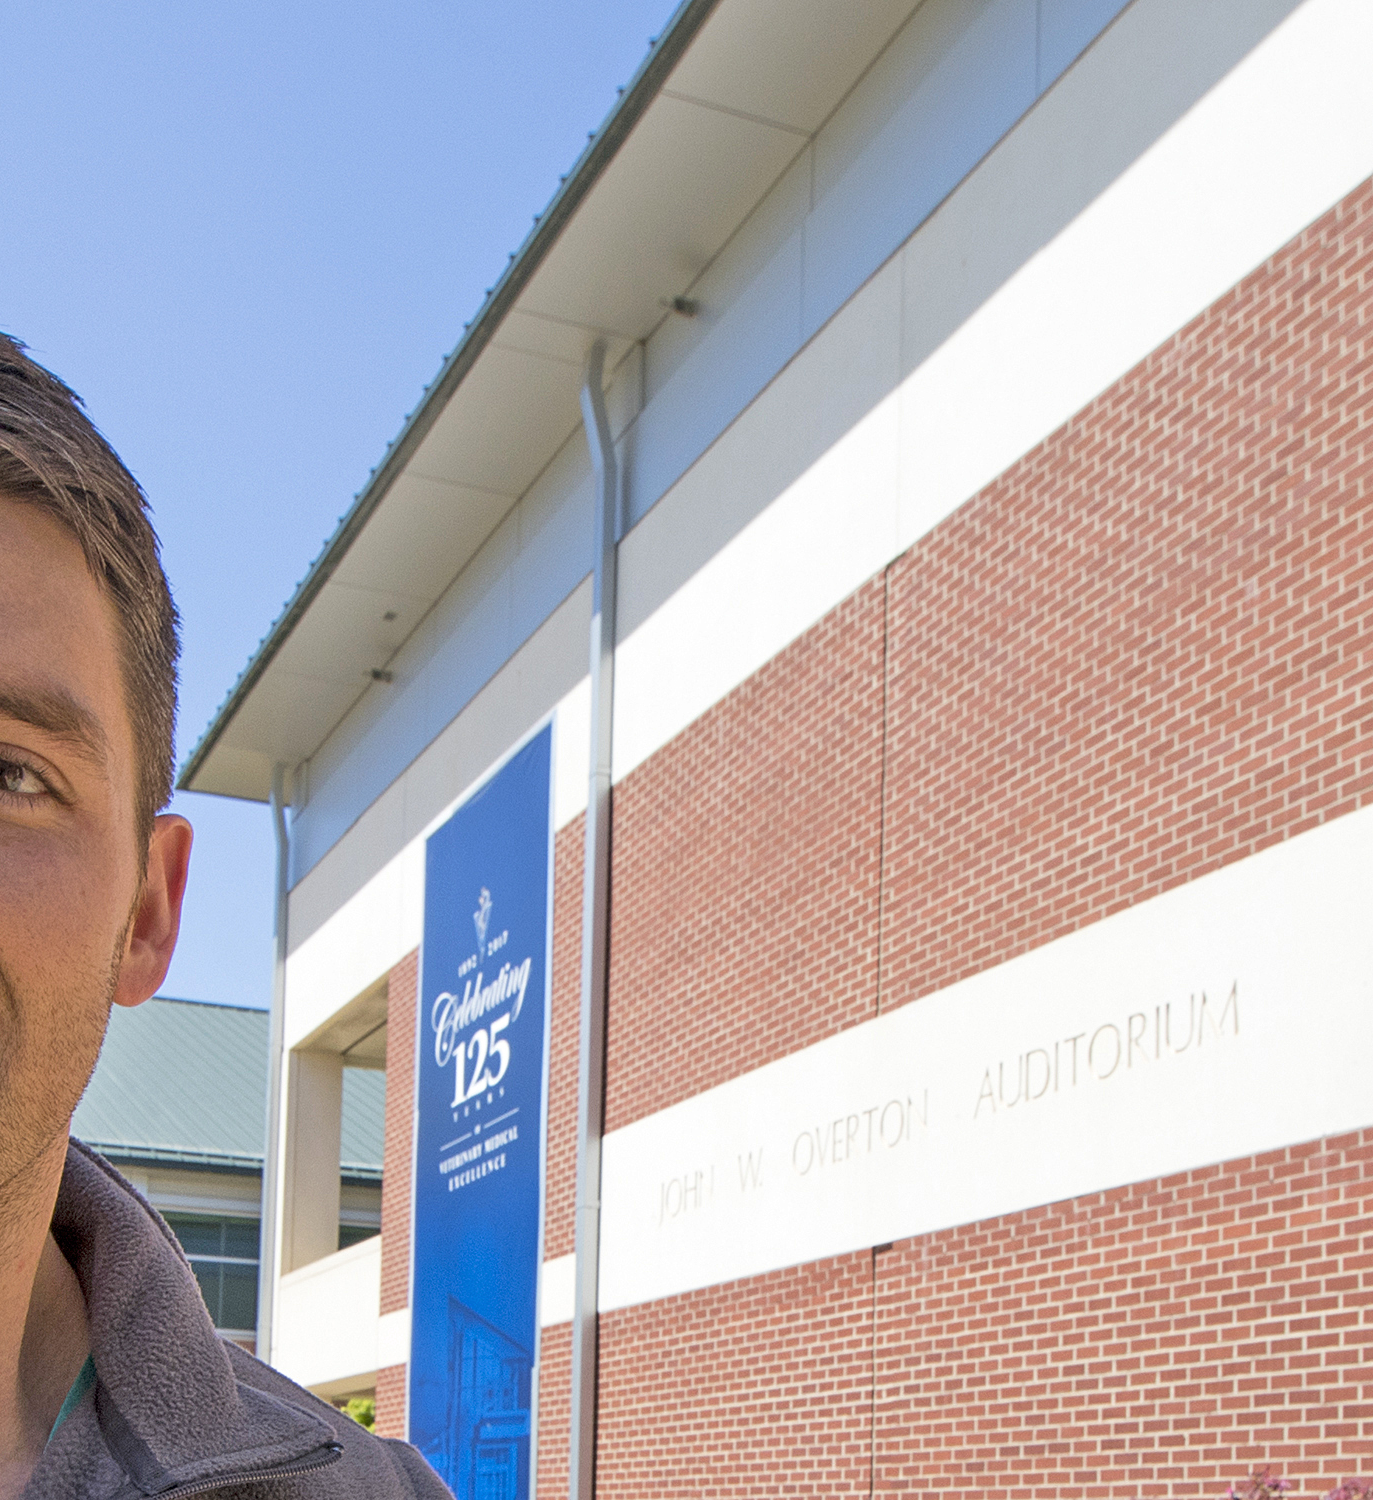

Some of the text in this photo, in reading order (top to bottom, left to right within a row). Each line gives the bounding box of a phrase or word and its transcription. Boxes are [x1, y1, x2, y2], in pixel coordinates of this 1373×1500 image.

[432, 957, 531, 1067] Celebrating
[451, 1012, 510, 1108] 125
[658, 978, 1239, 1228] JOHN W. OVERTON AUDITORIUM
